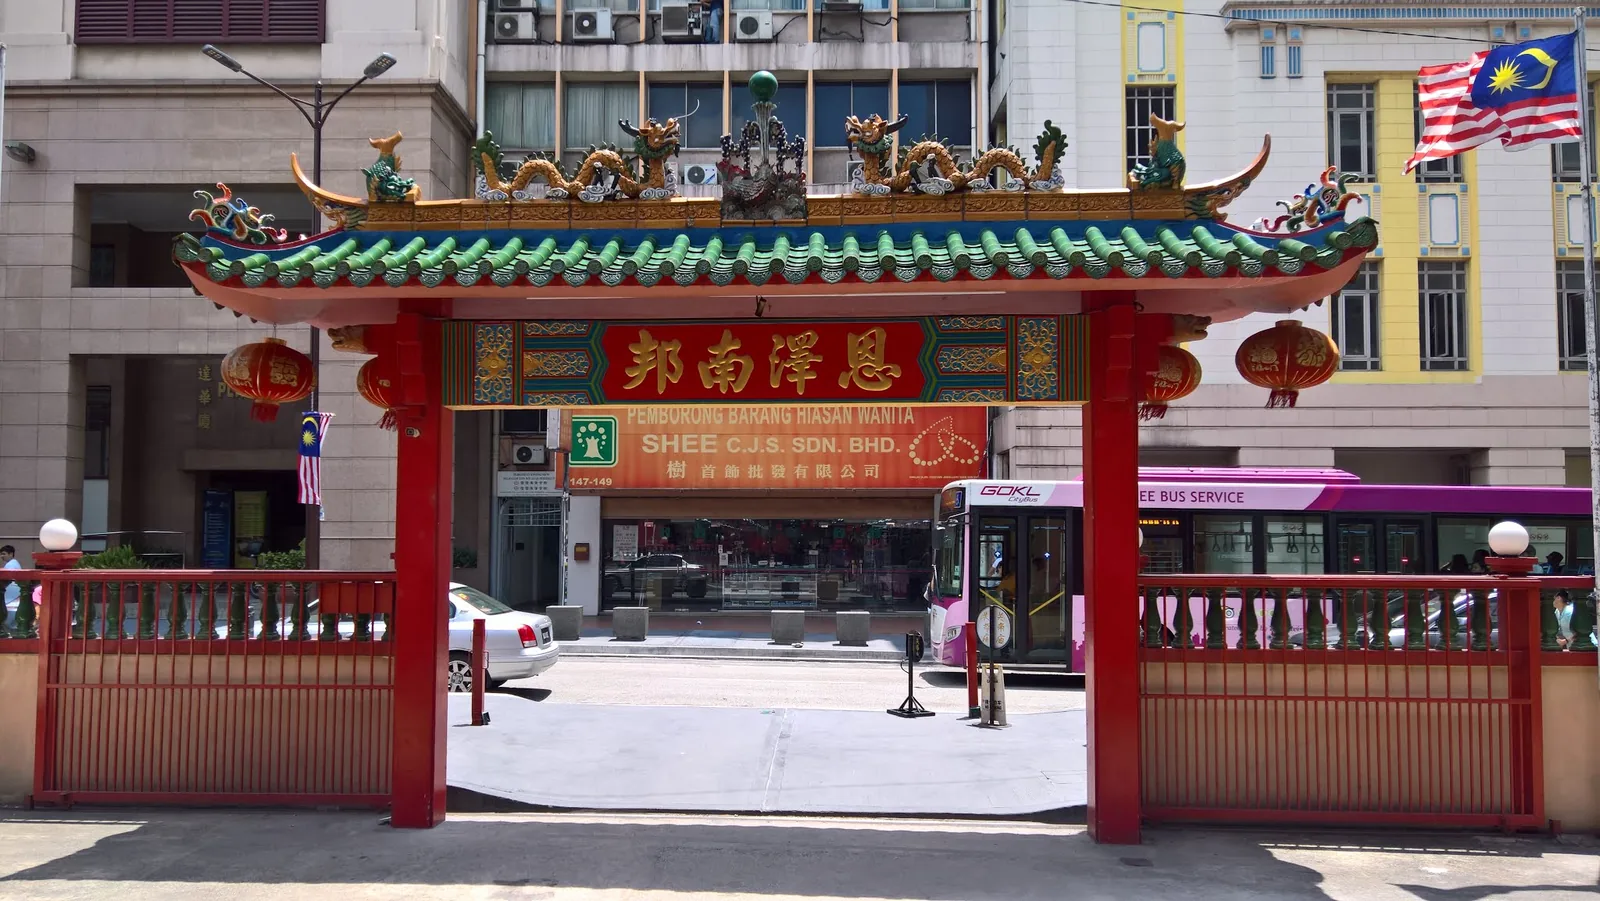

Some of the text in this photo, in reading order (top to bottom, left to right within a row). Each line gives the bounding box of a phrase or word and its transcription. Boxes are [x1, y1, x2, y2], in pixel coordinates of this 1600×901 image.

[627, 406, 915, 425] PEMBORONG BARANG HIASAN WANITA
[642, 434, 901, 453] SHEE C.J.S. SDN. BHD.
[570, 477, 613, 486] 147-149
[980, 486, 1041, 496] GOKL
[1139, 490, 1245, 503] EE BUS SERVICE
